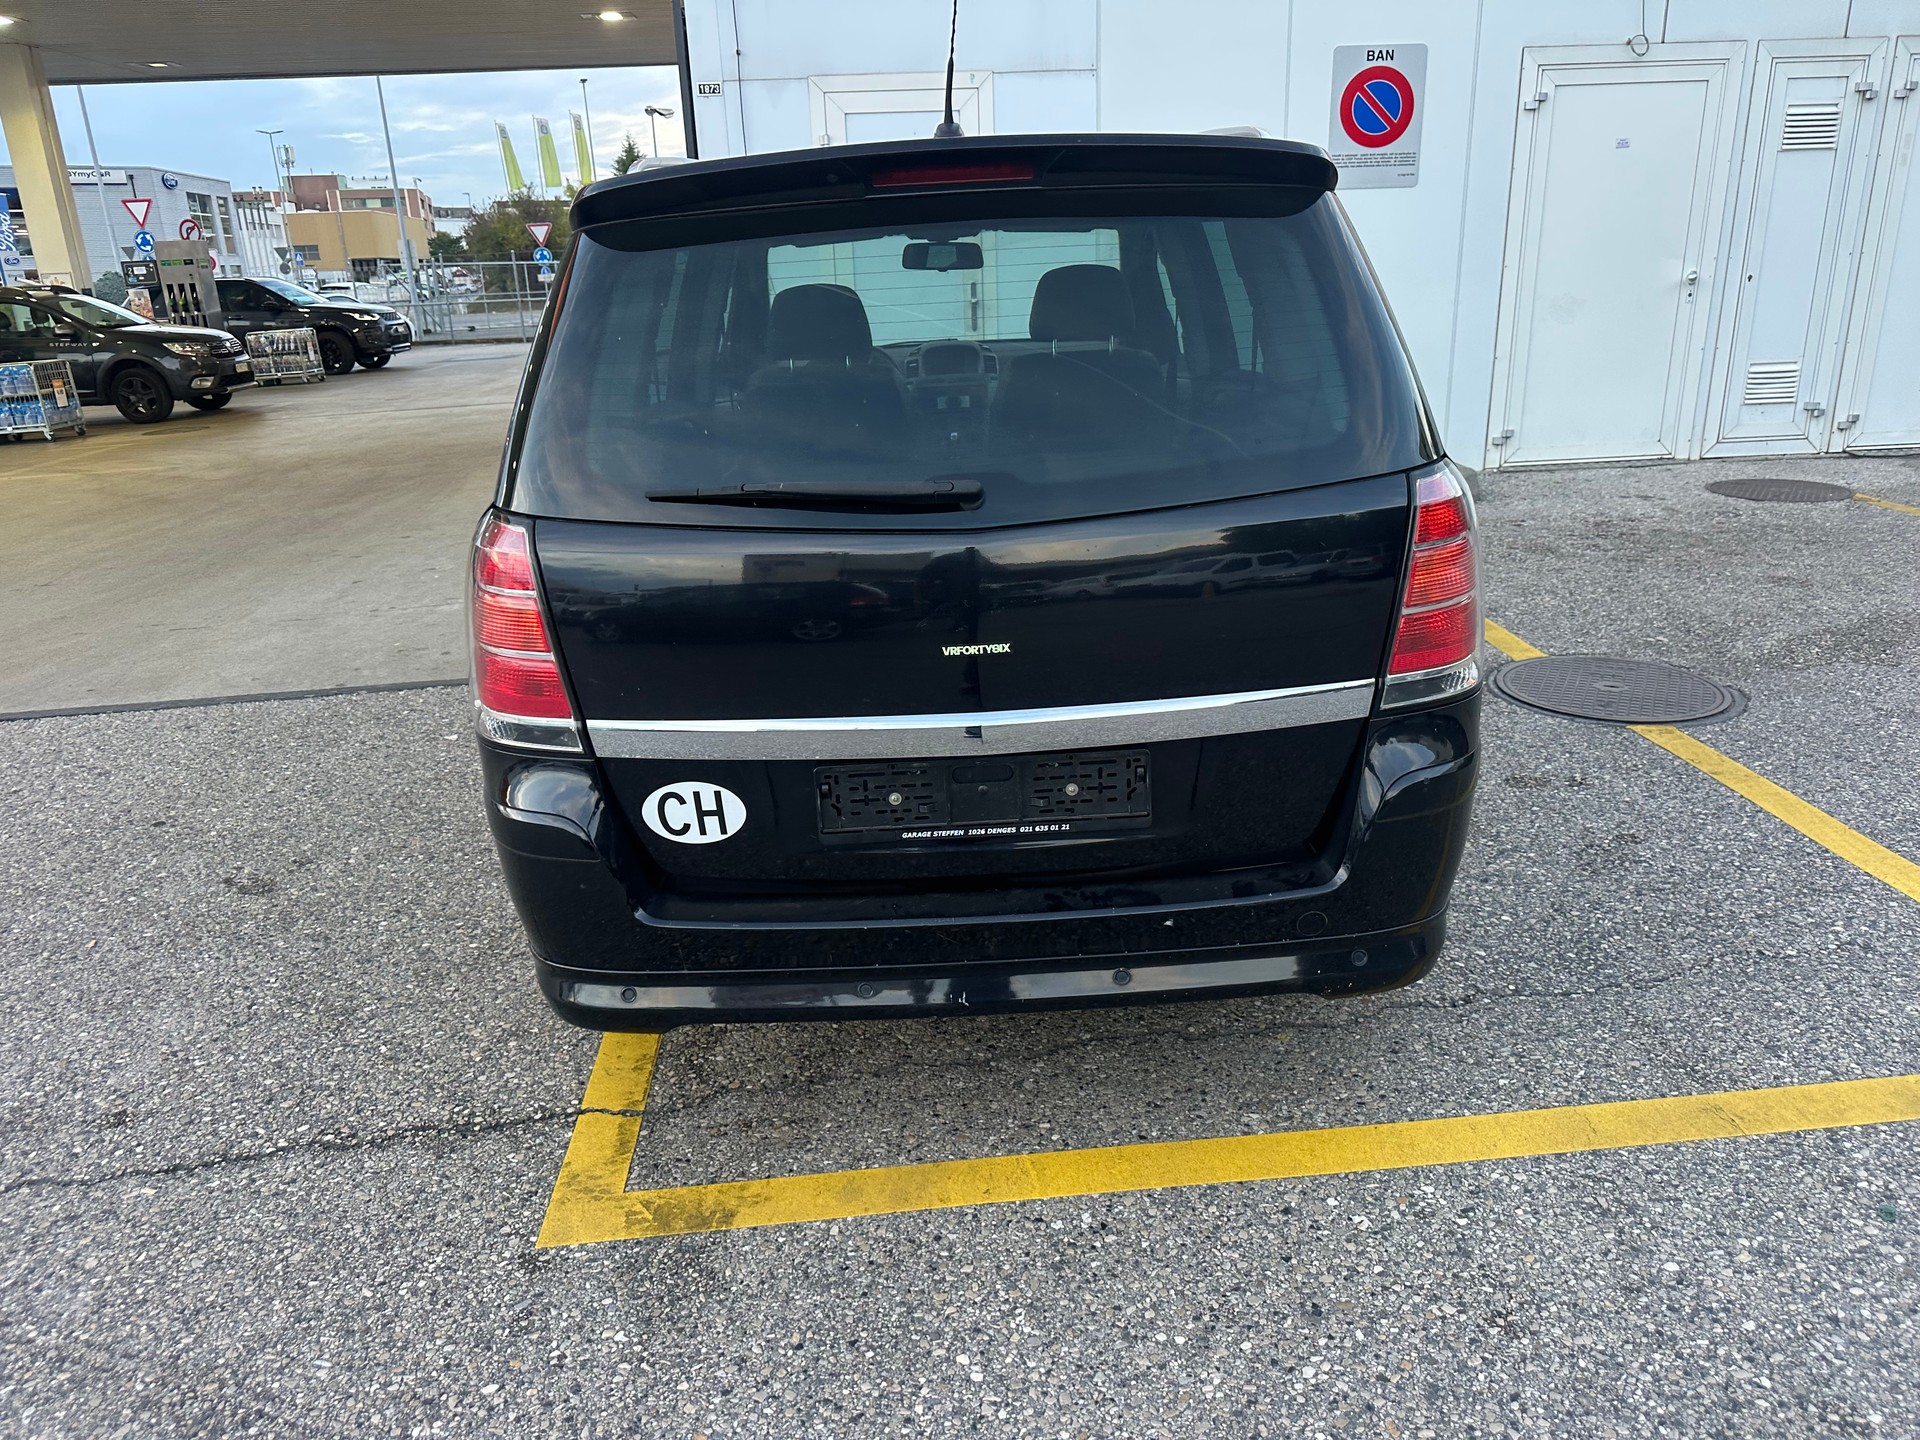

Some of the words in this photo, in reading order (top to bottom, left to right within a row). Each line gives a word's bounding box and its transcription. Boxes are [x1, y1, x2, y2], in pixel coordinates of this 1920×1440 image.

[1367, 49, 1394, 61] BAN
[700, 85, 719, 93] 1873
[657, 790, 728, 836] CH
[902, 831, 932, 839] GARAGE
[933, 829, 965, 837] STEFFEN
